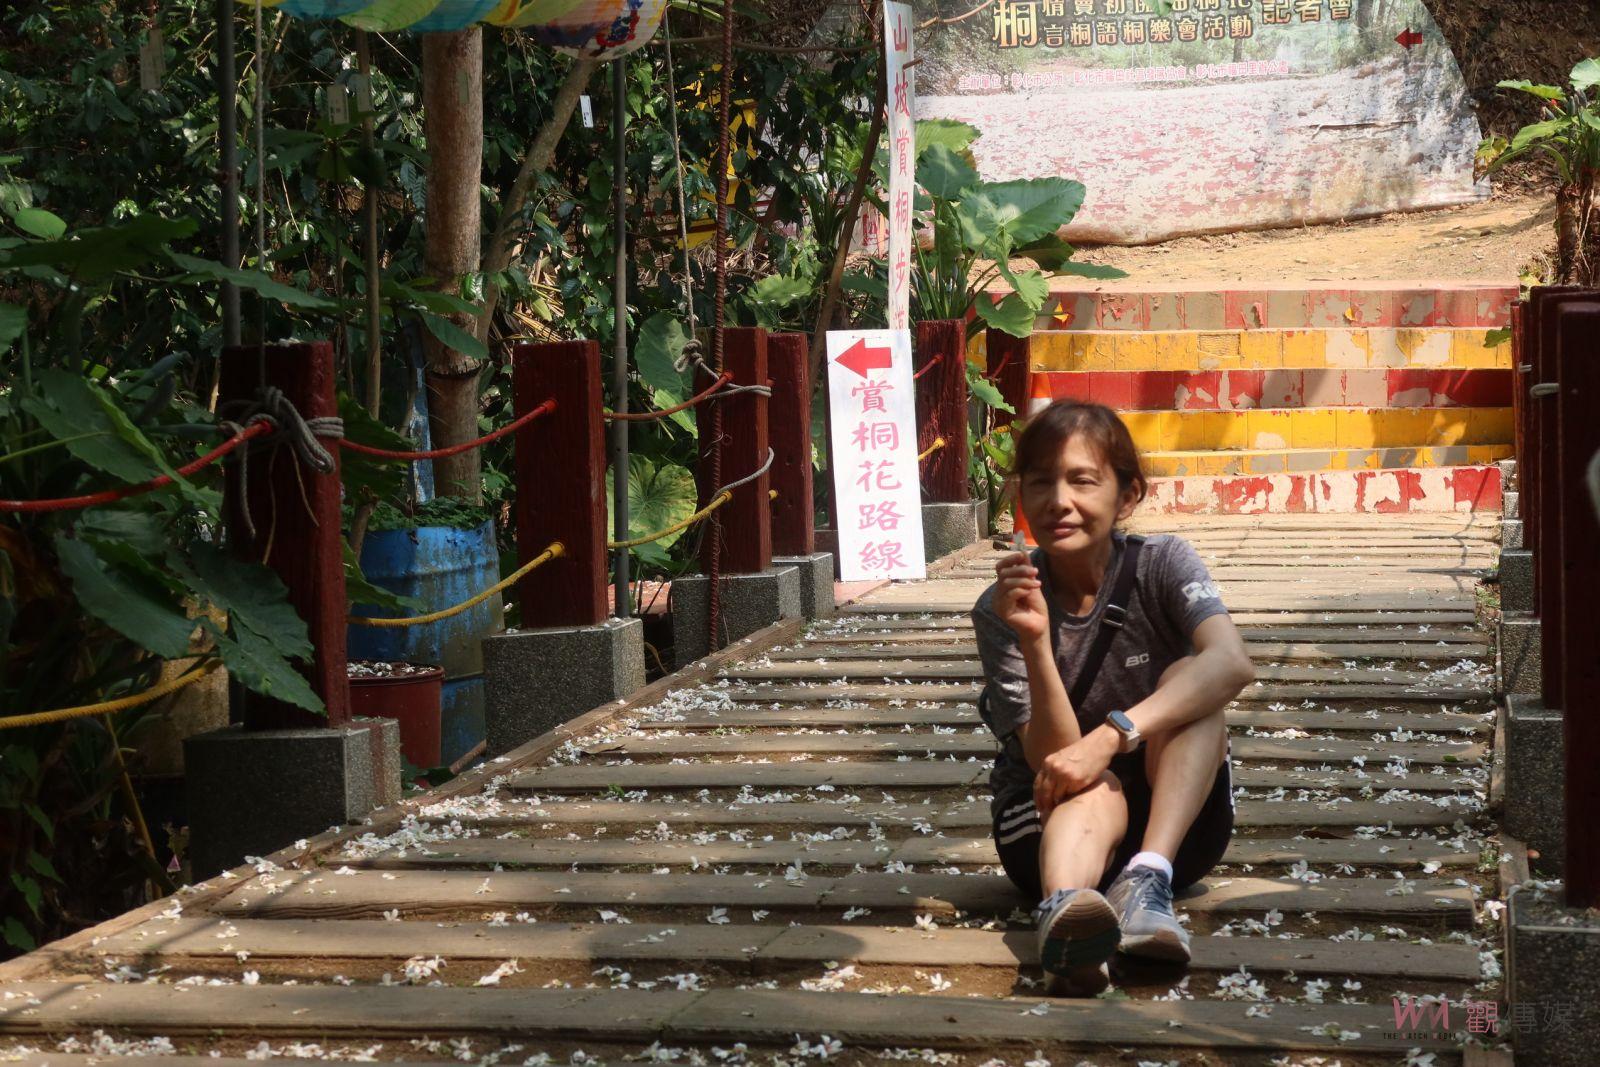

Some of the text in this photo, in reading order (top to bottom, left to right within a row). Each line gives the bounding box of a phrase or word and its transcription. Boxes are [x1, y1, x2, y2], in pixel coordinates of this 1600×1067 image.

[1044, 16, 1252, 47] 言桐語桐樂會活動
[851, 379, 909, 572] 賞桐花路線
